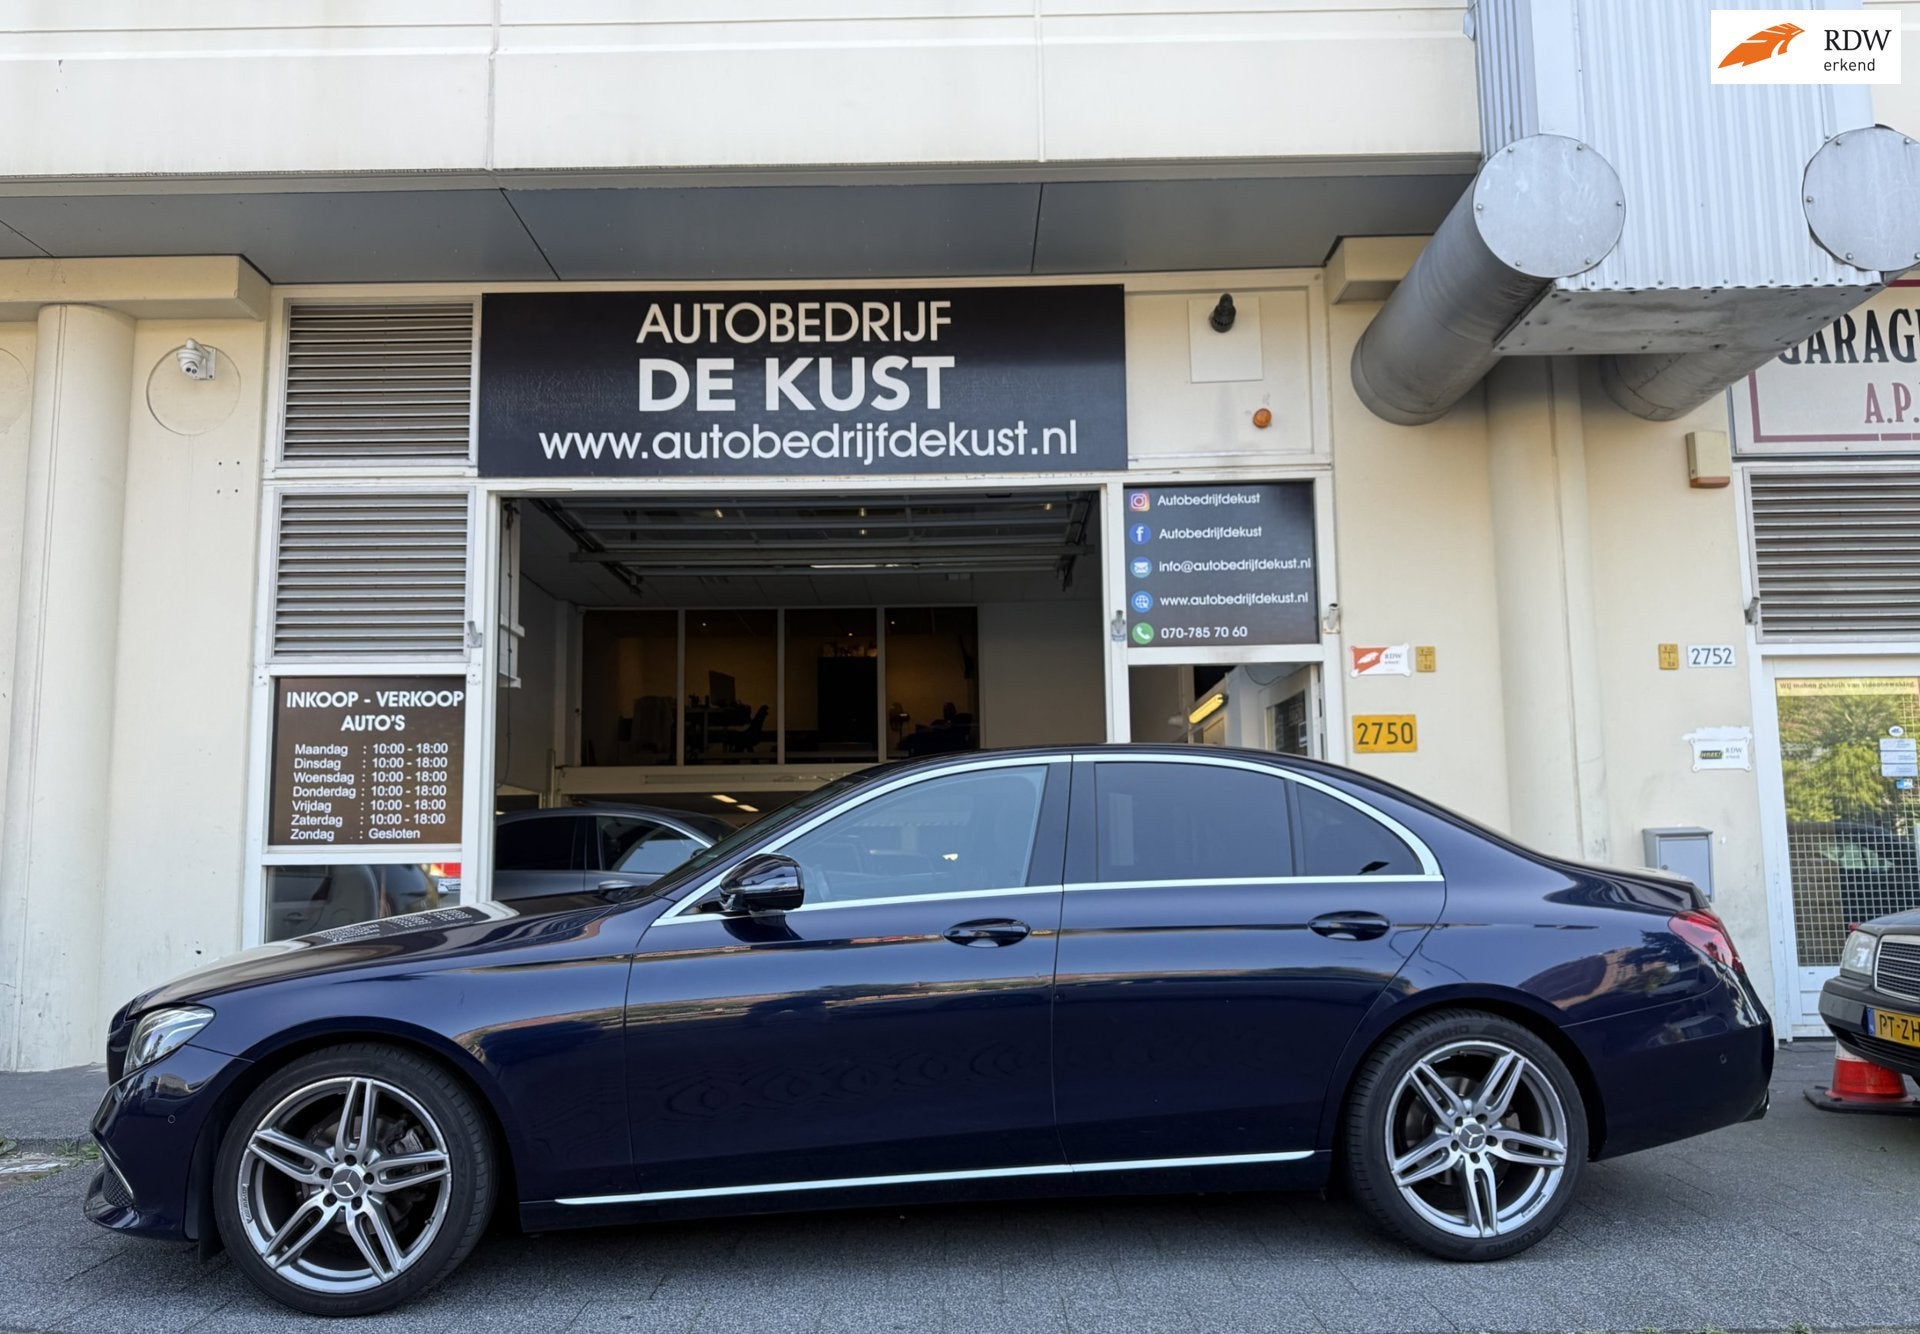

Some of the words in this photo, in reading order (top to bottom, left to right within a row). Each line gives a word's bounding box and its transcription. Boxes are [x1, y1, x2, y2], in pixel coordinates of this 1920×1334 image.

[636, 301, 951, 343] AUTOBEDRIJF
[1777, 308, 1920, 365] ARAG
[639, 358, 736, 412] DE
[765, 356, 955, 412] KUST
[539, 420, 1077, 466] www.autobedrijfdekust.nl
[1157, 493, 1260, 507] Autobedrijfdekust
[1159, 526, 1262, 540] Autobedrijfdekust
[1159, 558, 1311, 573] info@autobedrijfdekust.nl
[1160, 593, 1308, 606] www.autobedrijfdekust.nl
[1161, 627, 1210, 639] 070-785
[1215, 626, 1229, 637] 70
[1232, 626, 1248, 637] 60
[1692, 648, 1732, 665] 2752
[287, 691, 358, 707] INKOOP
[376, 691, 464, 707] VERKOOP
[341, 715, 405, 731] AUTO'S
[1357, 722, 1413, 745] 2750
[295, 744, 348, 757] Maandag
[373, 743, 404, 754] 10:00
[416, 743, 448, 753] 18:00
[294, 758, 341, 771] Dinsdag
[372, 757, 404, 768] 10:00
[415, 757, 448, 767] 18:00
[293, 772, 354, 784] Woensdag
[372, 772, 403, 782] 10:00
[415, 771, 447, 781] 18:00
[293, 786, 356, 798] Donderdag
[371, 786, 403, 796] 10:00
[414, 785, 446, 795] 18:00
[292, 800, 331, 813] Vrijdag
[370, 800, 402, 810] 10:00
[414, 799, 446, 810] 18:00
[291, 814, 342, 827] Zaterdag
[370, 814, 402, 824] 10:00
[414, 814, 445, 824] 18:00
[290, 828, 334, 841] Zondag
[369, 828, 420, 839] Gesloten
